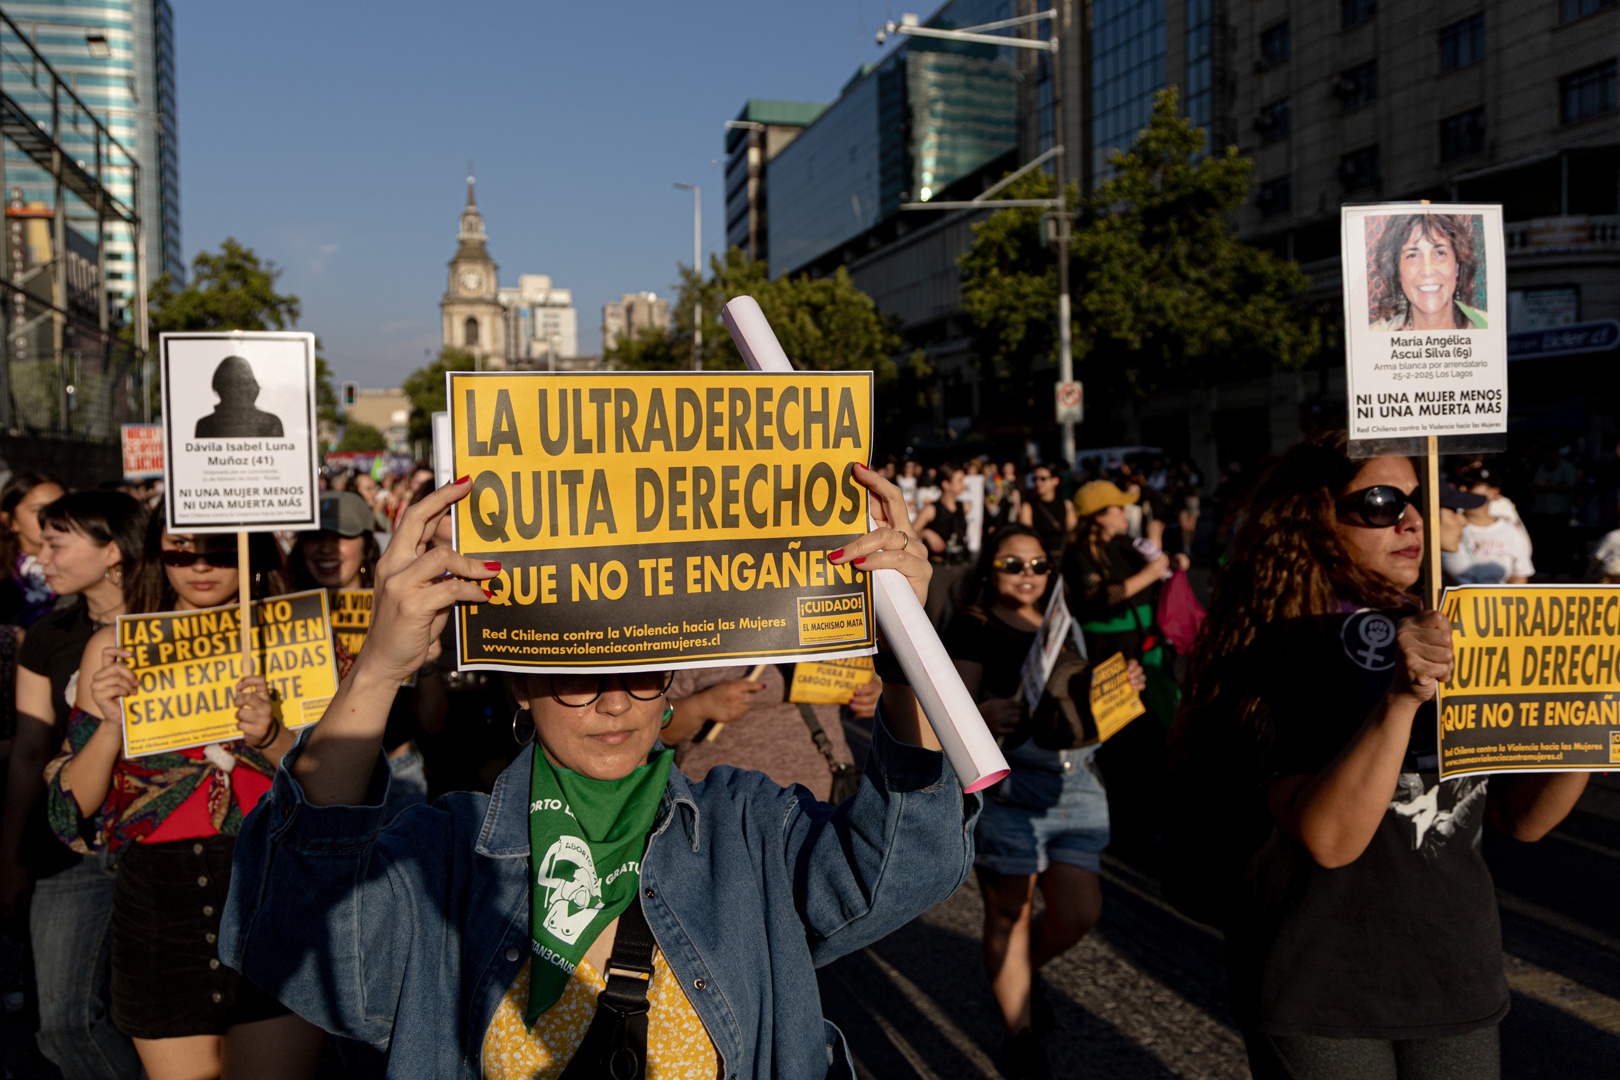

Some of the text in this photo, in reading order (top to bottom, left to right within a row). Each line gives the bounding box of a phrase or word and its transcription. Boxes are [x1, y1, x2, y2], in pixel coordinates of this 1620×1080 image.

[1391, 334, 1472, 348] María Angélica
[1390, 347, 1472, 360] Ascui Silva (69)
[1374, 359, 1488, 371] Arma blanca por arrendatario
[1392, 370, 1473, 380] 25-2-2025 Los Lagos
[1356, 389, 1502, 406] NI UNA MUJER MENOS
[1357, 407, 1374, 419] NI
[1379, 405, 1414, 418] UNA
[1419, 402, 1471, 416] MUERTA
[466, 386, 862, 457] LA ULTRADERECHA
[1357, 425, 1369, 433] Red
[1371, 424, 1397, 432] Chilena
[1399, 424, 1420, 432] contra
[1428, 422, 1454, 430] Violencia
[1456, 421, 1470, 429] hacia
[1481, 420, 1501, 429] Mujeres
[185, 441, 295, 452] Dávila Isabel Luna
[207, 456, 274, 466] Muñoz (41)
[179, 486, 304, 498] NI UNA MUJER MENOS
[183, 496, 303, 510] NI UNA MUERTA MÁS
[469, 461, 860, 543] QUITA DERECHOS
[571, 560, 628, 602] NO
[638, 557, 674, 597] TE
[801, 597, 862, 617] ¡CUIDADO!
[124, 619, 164, 646] LAS
[258, 600, 293, 625] NO
[803, 618, 863, 632] EL MACHISMO MATA
[1473, 595, 1620, 638] ULTRADEREC
[482, 616, 787, 641] Red Chilena contra la Violencia hacia las Mujeres
[159, 616, 325, 665] PROSTTUYEN
[482, 633, 721, 655] www.nomasviolenciacontramujeres.cl
[1521, 643, 1620, 687] DERECH
[140, 668, 175, 693] ON
[1482, 702, 1514, 728] NO
[1519, 702, 1540, 726] TE
[1544, 694, 1620, 726] ENGAÑ
[1454, 745, 1475, 756] Chilena
[1476, 744, 1497, 754] contra
[1499, 743, 1506, 752] la
[1507, 742, 1539, 752] Violencia
[1540, 741, 1559, 751] hacia
[1561, 740, 1572, 750] las
[1574, 741, 1603, 752] Mujeres
[530, 799, 562, 814] ORTO
[565, 842, 593, 867] ABORTO
[606, 861, 640, 885] GRATU
